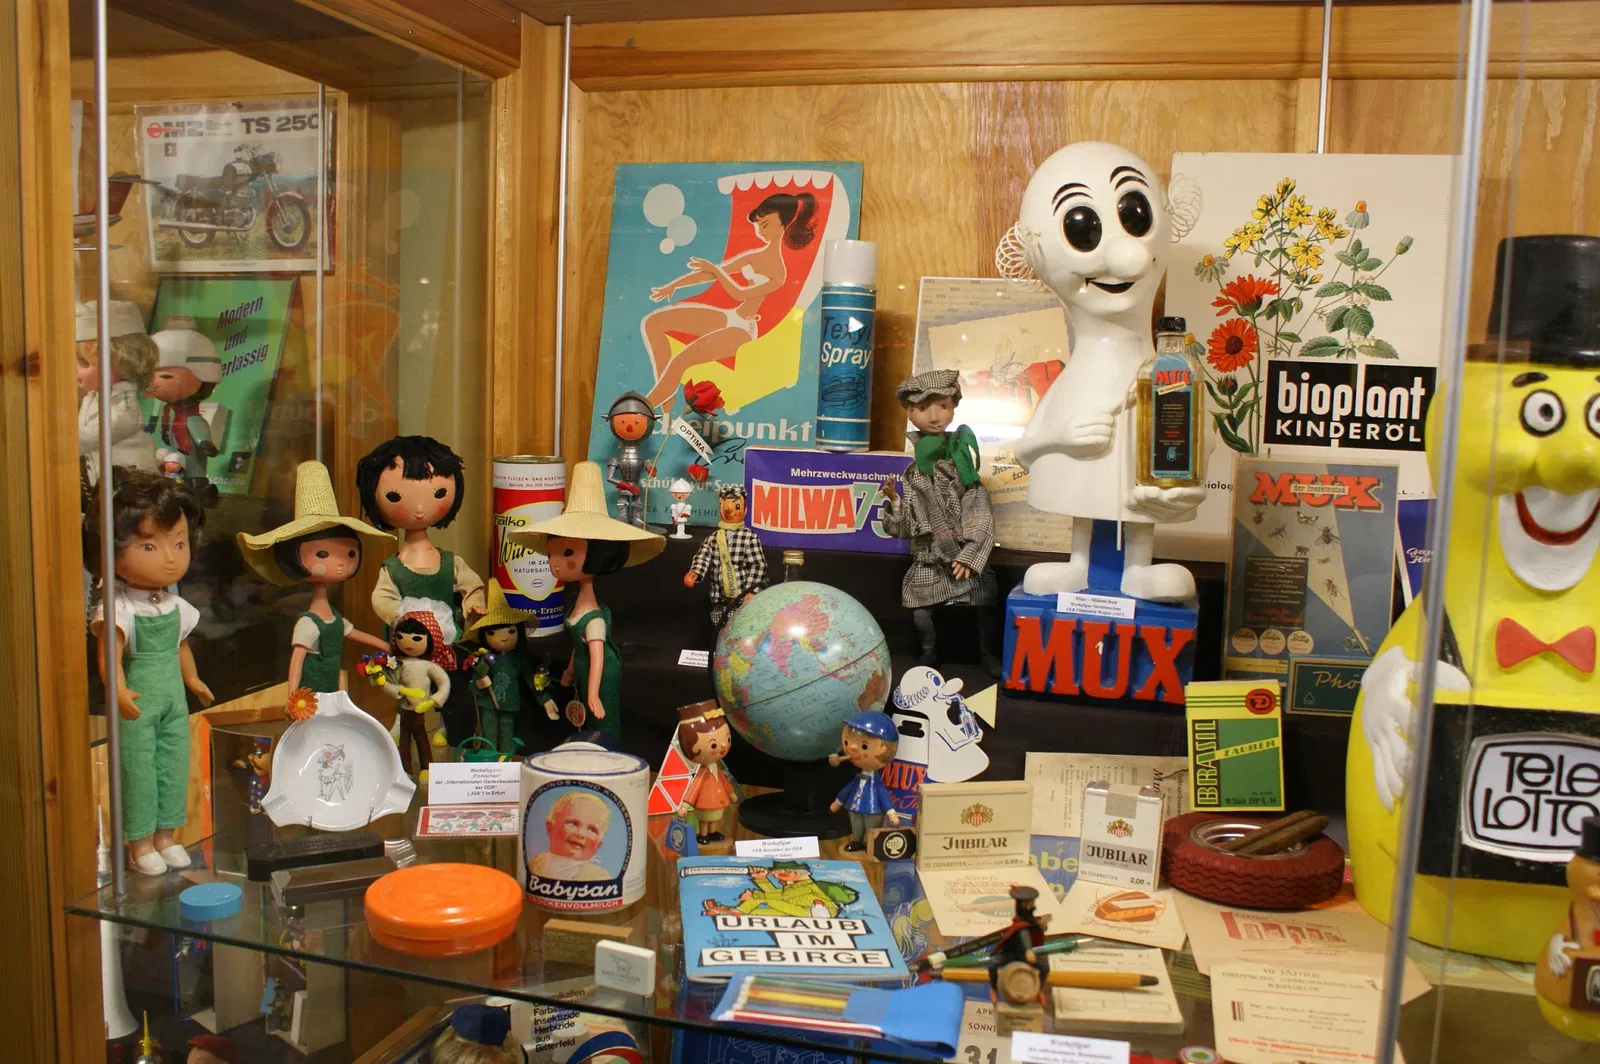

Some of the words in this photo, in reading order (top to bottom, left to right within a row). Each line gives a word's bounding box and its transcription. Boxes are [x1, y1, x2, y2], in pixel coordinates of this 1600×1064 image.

[241, 116, 272, 135] TS
[217, 295, 263, 330] Modern
[223, 325, 249, 352] und
[820, 341, 872, 371] Spray
[1154, 369, 1192, 386] MUX
[1277, 363, 1426, 422] bioplant
[679, 424, 705, 453] OPTIMA
[1276, 419, 1422, 443] KINDERÖL
[1249, 472, 1384, 511] MUX
[752, 484, 856, 531] MILWA
[1005, 615, 1194, 705] MUX
[1224, 739, 1276, 757] ZAUBER
[1194, 720, 1219, 805] BRASIL
[579, 780, 600, 792] UND
[881, 761, 929, 793] MUX
[942, 836, 1008, 851] JUBILAR
[1086, 844, 1148, 866] JUBILAR
[1087, 871, 1118, 881] ZIGARETTEN
[1129, 877, 1145, 886] 2,00
[529, 874, 619, 900] Babysan
[722, 916, 859, 931] URLAUB
[794, 934, 836, 946] IM
[709, 949, 884, 966] GEBIRGE
[534, 1010, 580, 1026] Insektizide
[534, 1020, 575, 1035] Herbizide
[535, 1034, 551, 1044] aus
[535, 1037, 576, 1053] Bitterfeld
